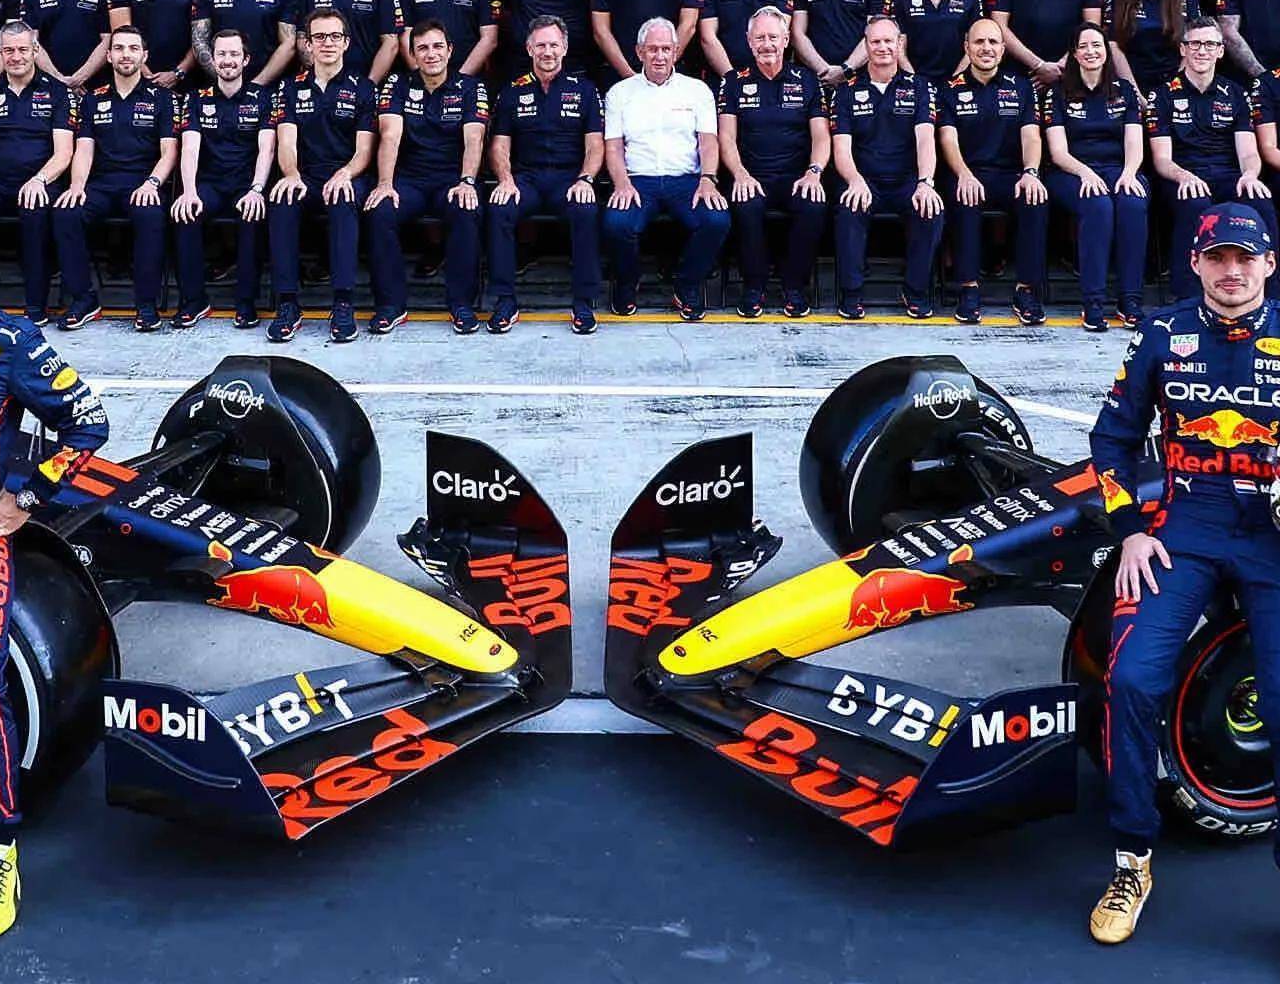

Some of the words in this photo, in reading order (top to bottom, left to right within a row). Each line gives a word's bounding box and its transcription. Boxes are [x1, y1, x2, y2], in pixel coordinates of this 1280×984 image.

[209, 383, 238, 403] Hard
[237, 390, 265, 410] Rock
[913, 390, 942, 409] Hard
[943, 385, 972, 405] Rock
[432, 470, 508, 502] Claro
[655, 478, 732, 507] Claro
[103, 695, 206, 743] Mobil
[826, 674, 961, 748] BYBI
[970, 700, 1077, 748] Mobil
[260, 707, 459, 840] Red
